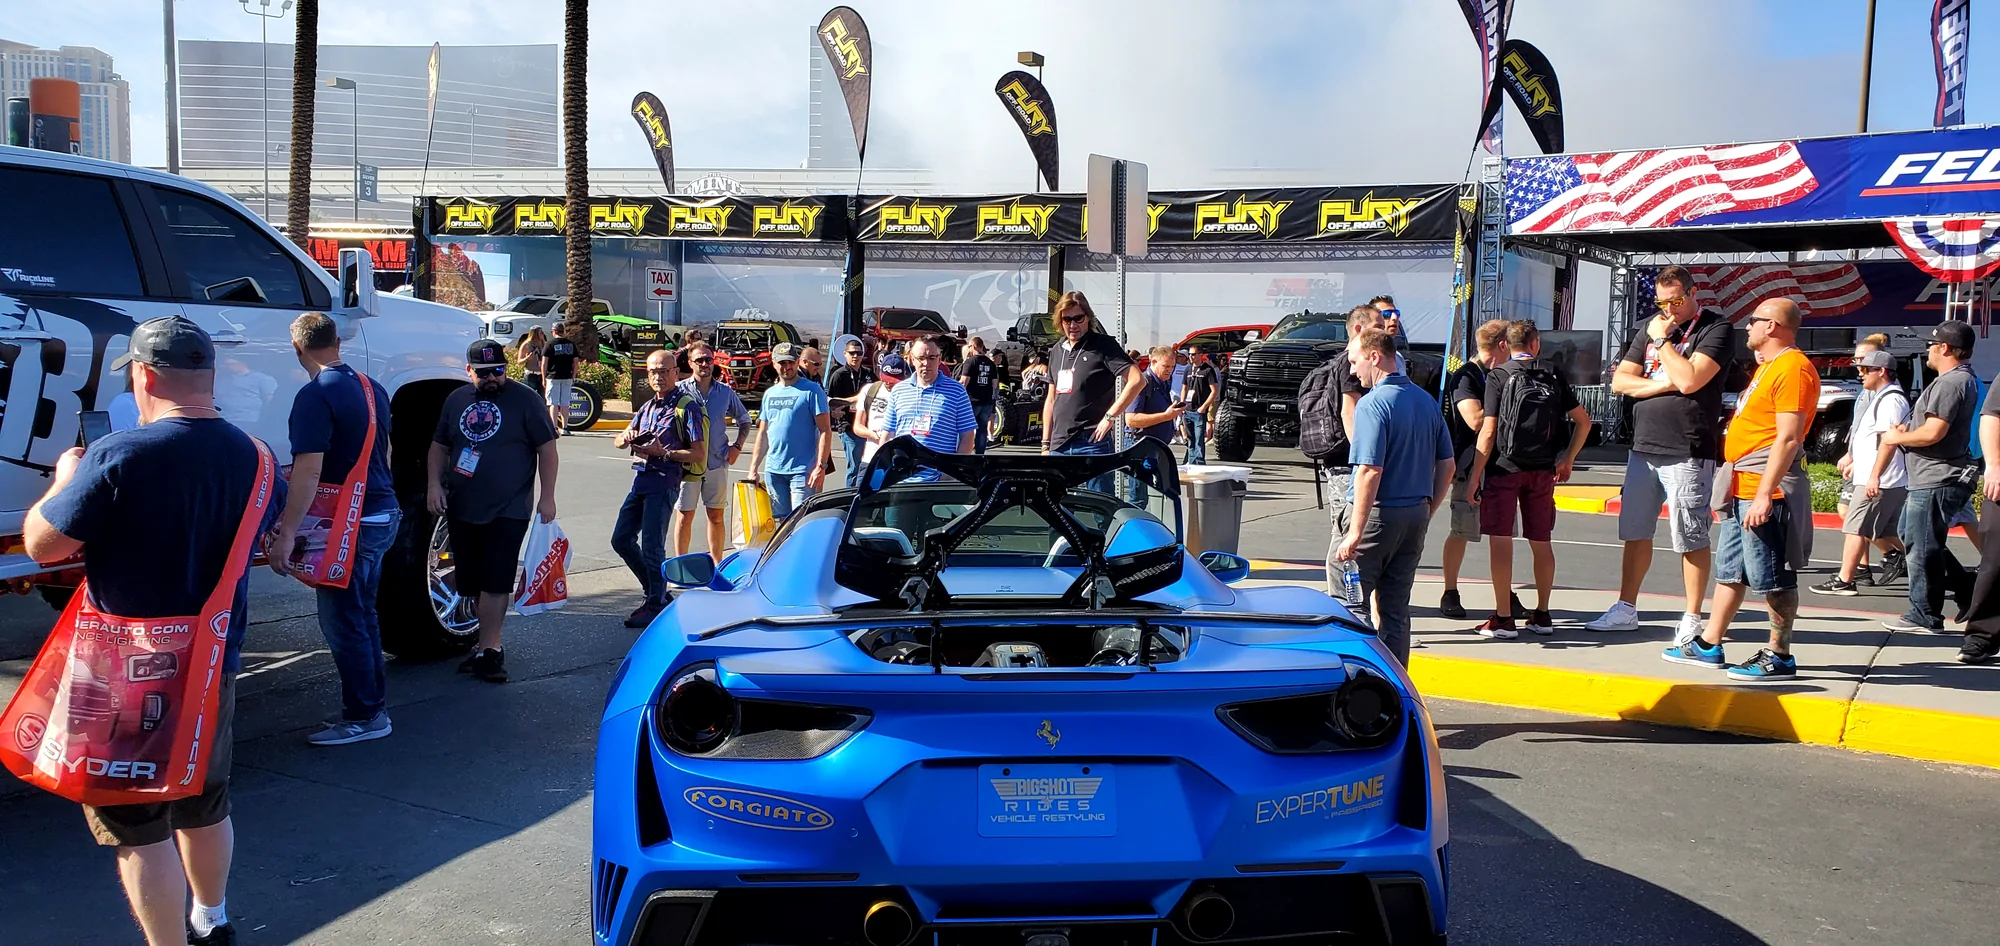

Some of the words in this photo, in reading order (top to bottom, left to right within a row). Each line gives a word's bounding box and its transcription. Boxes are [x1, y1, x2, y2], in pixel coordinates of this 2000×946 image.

[818, 15, 869, 79] FURY
[1503, 49, 1560, 118] FURY
[1514, 82, 1533, 105] ROAD
[633, 98, 671, 149] FURY
[997, 78, 1055, 136] FURY
[1006, 92, 1017, 106] OFF
[1016, 105, 1032, 124] ROAD
[365, 186, 371, 196] 3
[445, 203, 500, 233] FURY
[669, 200, 736, 236] FURY
[753, 199, 825, 237] FURY
[879, 199, 957, 239] FURY
[976, 198, 1060, 240] FURY
[1193, 194, 1293, 240] FURY
[1203, 224, 1225, 232] OFF
[1226, 223, 1258, 232] ROAD
[1317, 190, 1425, 237] FURY
[1327, 222, 1350, 230] OFF
[1352, 221, 1386, 230] ROAD
[651, 271, 673, 285] TAXI
[257, 456, 271, 508] SPYDER
[337, 481, 365, 563] SPYDER
[106, 633, 171, 647] LIGHTING
[1016, 778, 1076, 796] BIGSHOT
[1256, 774, 1385, 823] EXPERTUNE
[691, 790, 829, 826] FORGIATO
[990, 814, 1036, 823] VEHICLE
[1042, 813, 1106, 822] RESTYLING
[1004, 800, 1091, 812] RIDES
